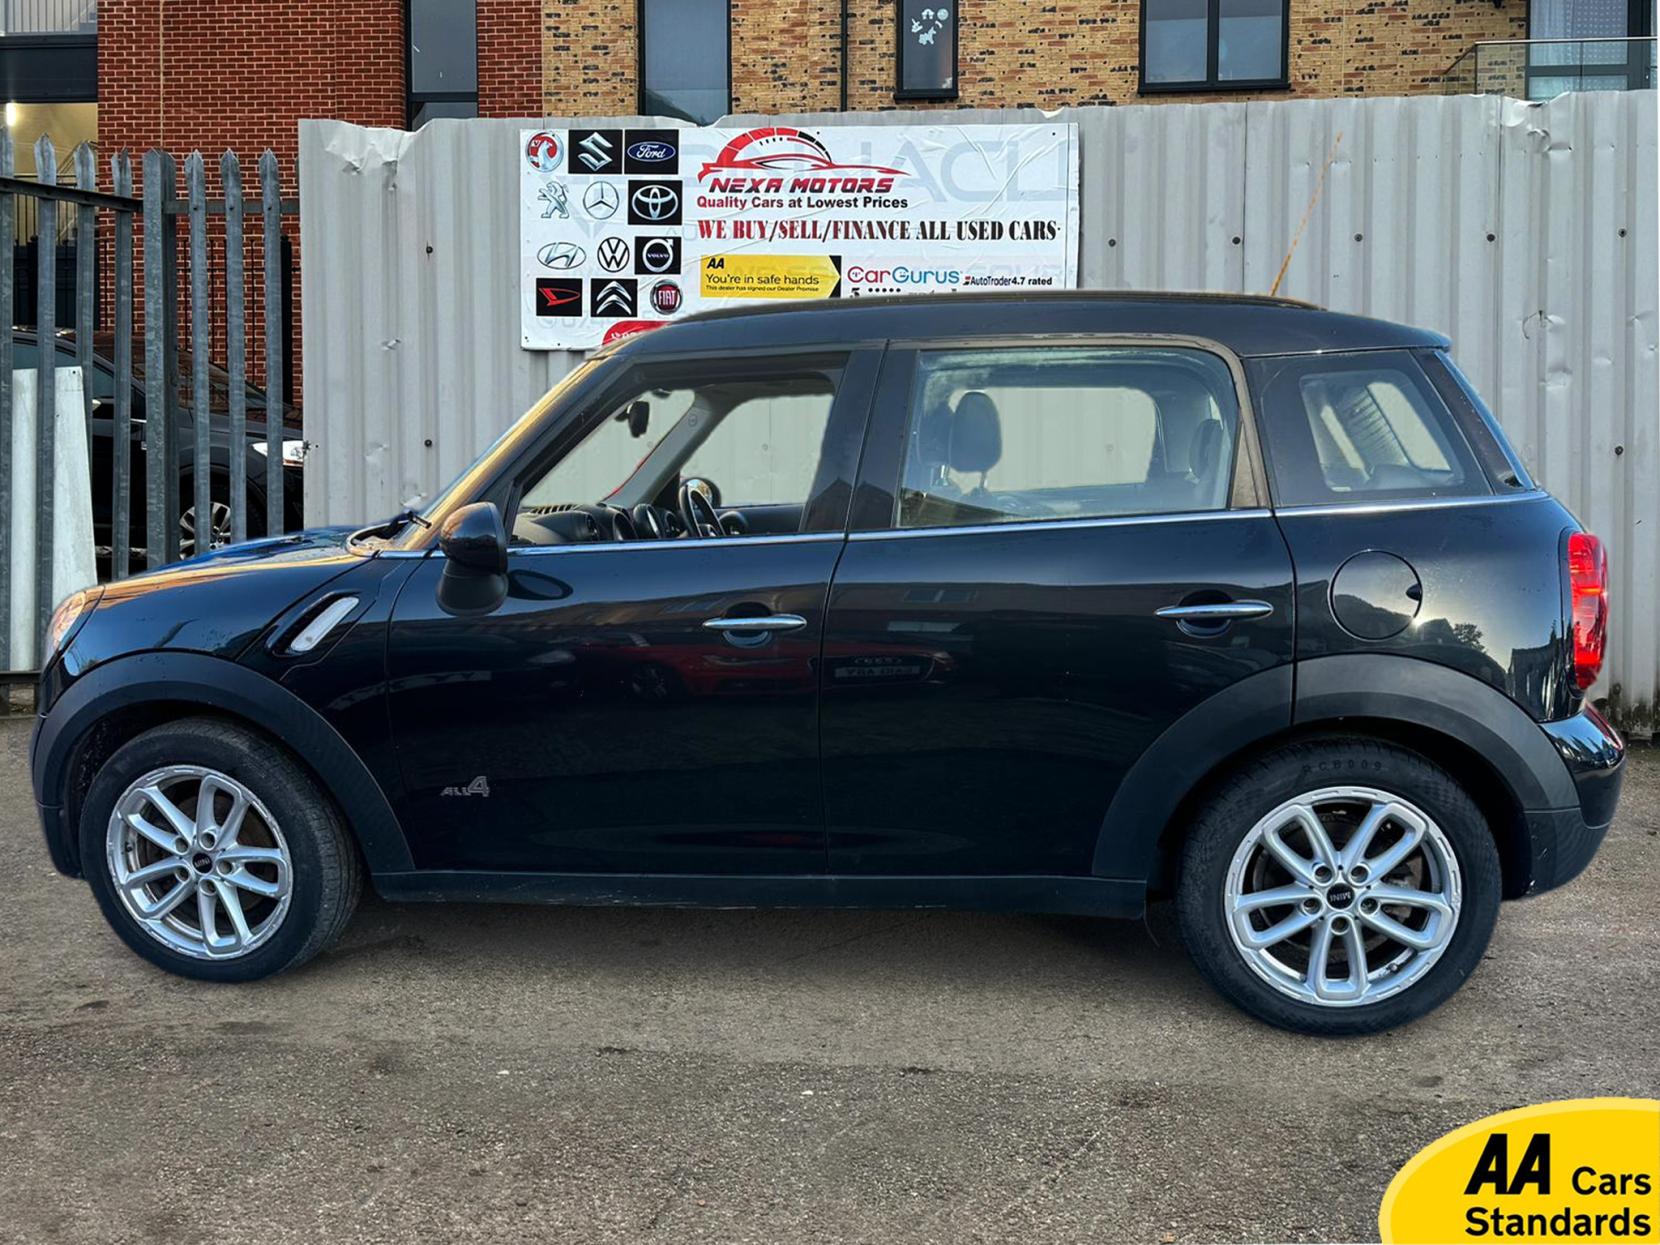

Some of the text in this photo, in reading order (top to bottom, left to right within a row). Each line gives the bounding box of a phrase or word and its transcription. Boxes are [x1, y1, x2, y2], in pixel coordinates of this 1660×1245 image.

[637, 143, 666, 158] Ford
[708, 177, 895, 194] NEXA MOTORS
[697, 195, 908, 210] Quality Cars at Lowest Prices
[698, 219, 727, 239] WE
[733, 219, 910, 243] BUY/SELL/FINANCE
[916, 220, 950, 240] ALL
[956, 220, 1004, 240] USED
[1008, 220, 1057, 240] CARS
[706, 257, 725, 269] AA
[705, 274, 820, 285] You're in safe hands
[847, 265, 960, 284] CarGurus
[1028, 277, 1053, 286] rated
[658, 291, 677, 306] FIAT
[1329, 891, 1352, 903] MINI
